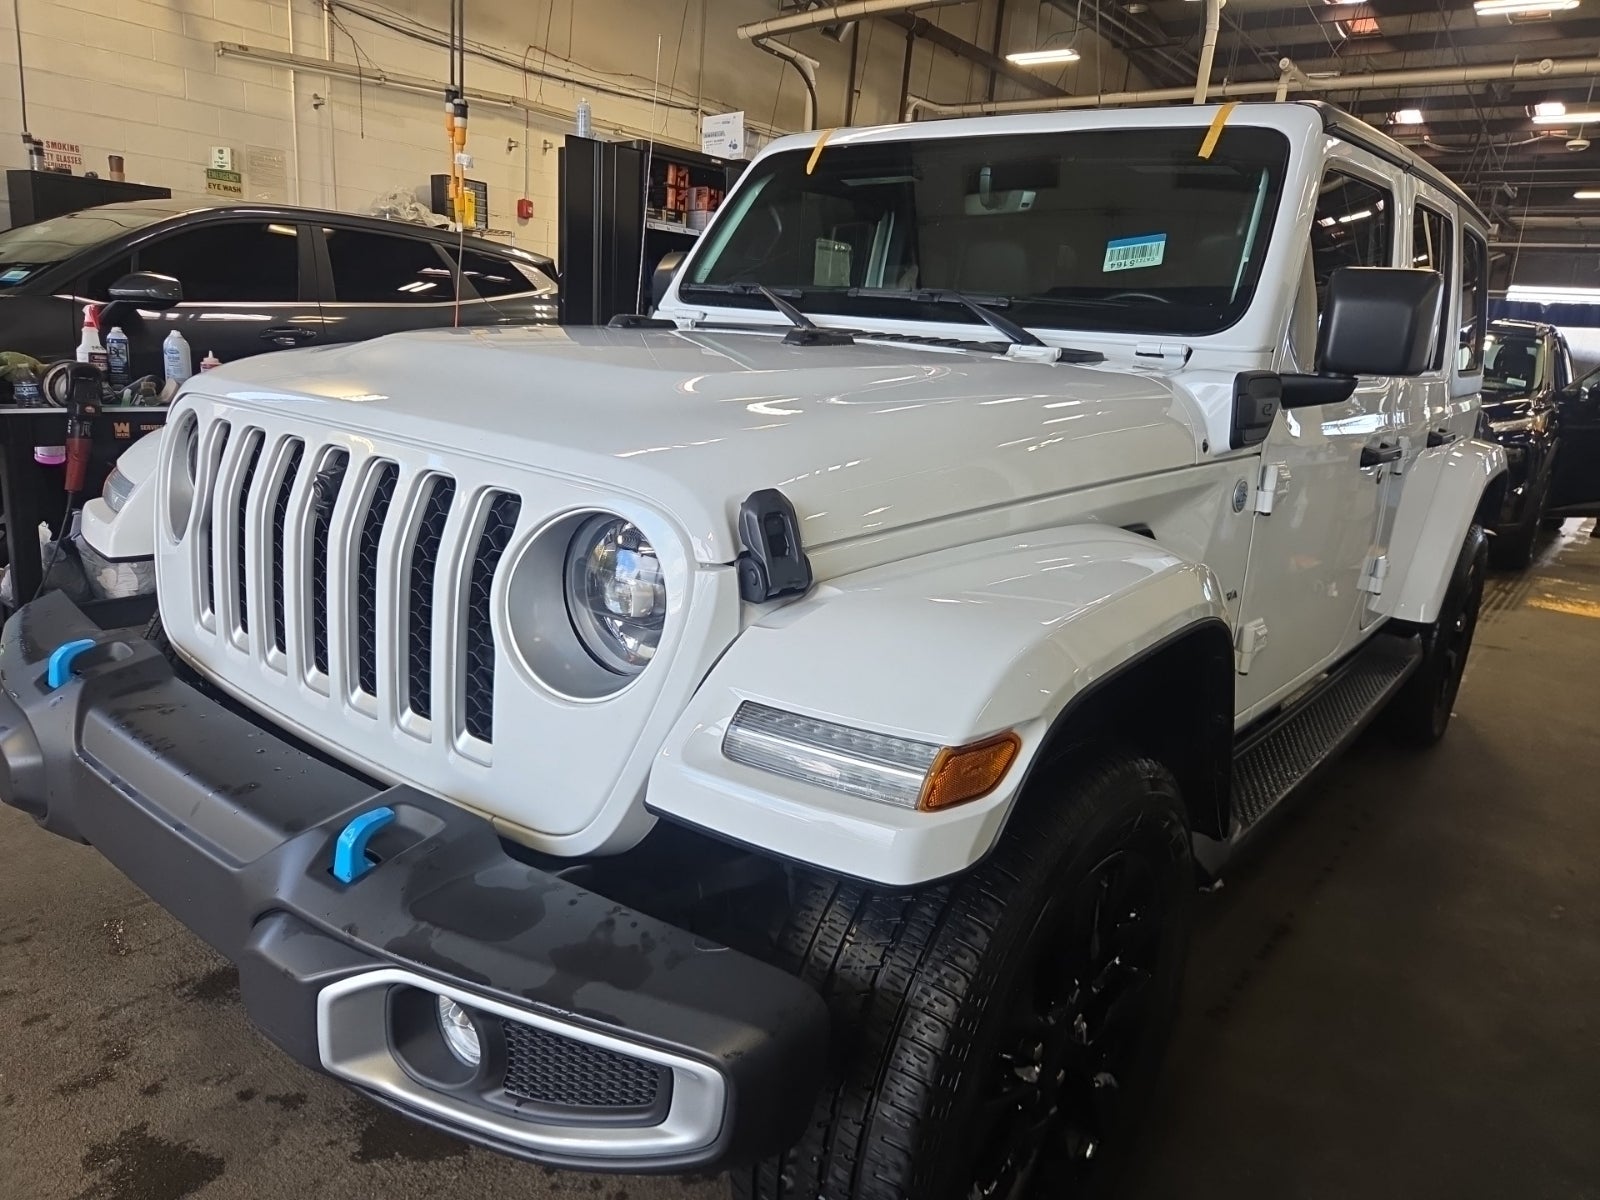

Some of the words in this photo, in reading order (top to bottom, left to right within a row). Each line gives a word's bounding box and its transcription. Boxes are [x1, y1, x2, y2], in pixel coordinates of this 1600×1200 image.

[45, 140, 80, 153] SMOKING
[56, 154, 82, 165] GLASSES
[208, 182, 222, 191] EYE
[222, 184, 242, 193] WASH
